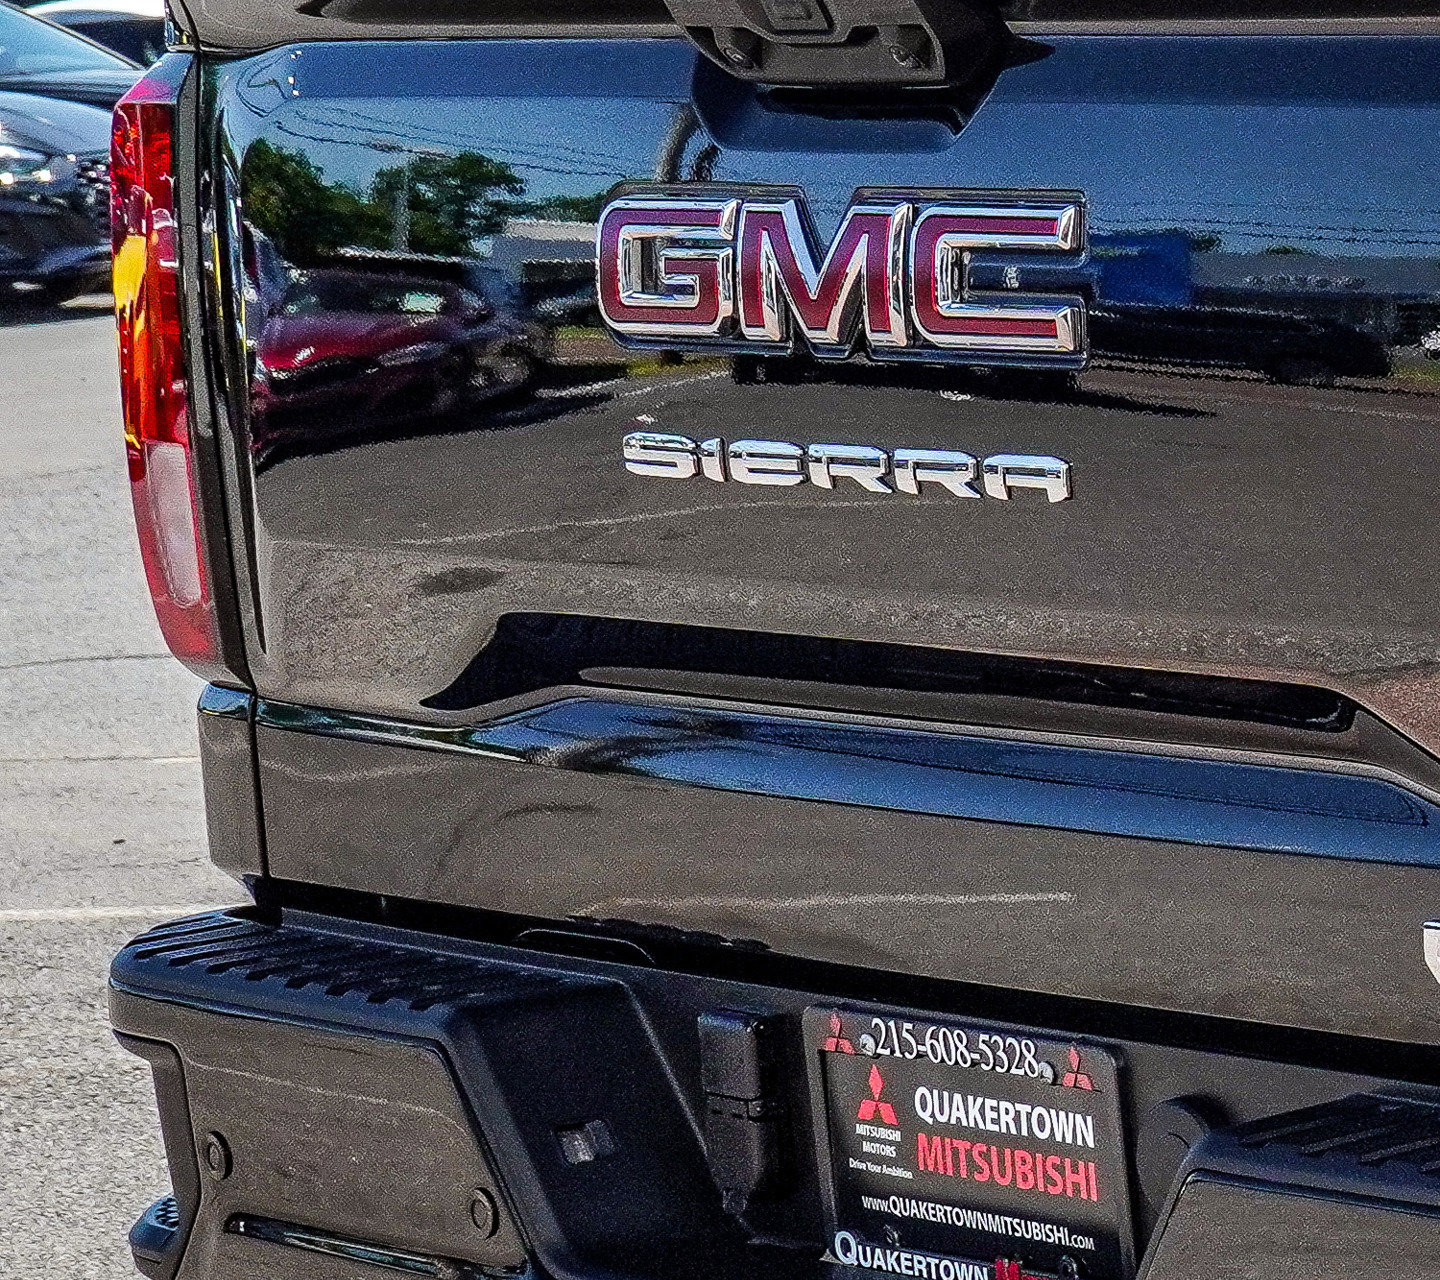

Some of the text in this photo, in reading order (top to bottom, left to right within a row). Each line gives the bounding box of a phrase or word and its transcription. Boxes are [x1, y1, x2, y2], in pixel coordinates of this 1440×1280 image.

[595, 194, 1087, 358] GMC
[622, 430, 1074, 504] SIERRA
[870, 1017, 1040, 1078] 215-608-5328
[855, 1123, 902, 1142] MITSUBISHI
[862, 1140, 897, 1158] MOTORS
[914, 1085, 1096, 1149] QUAKERTOWN
[916, 1132, 1099, 1202] MITSUBISHI
